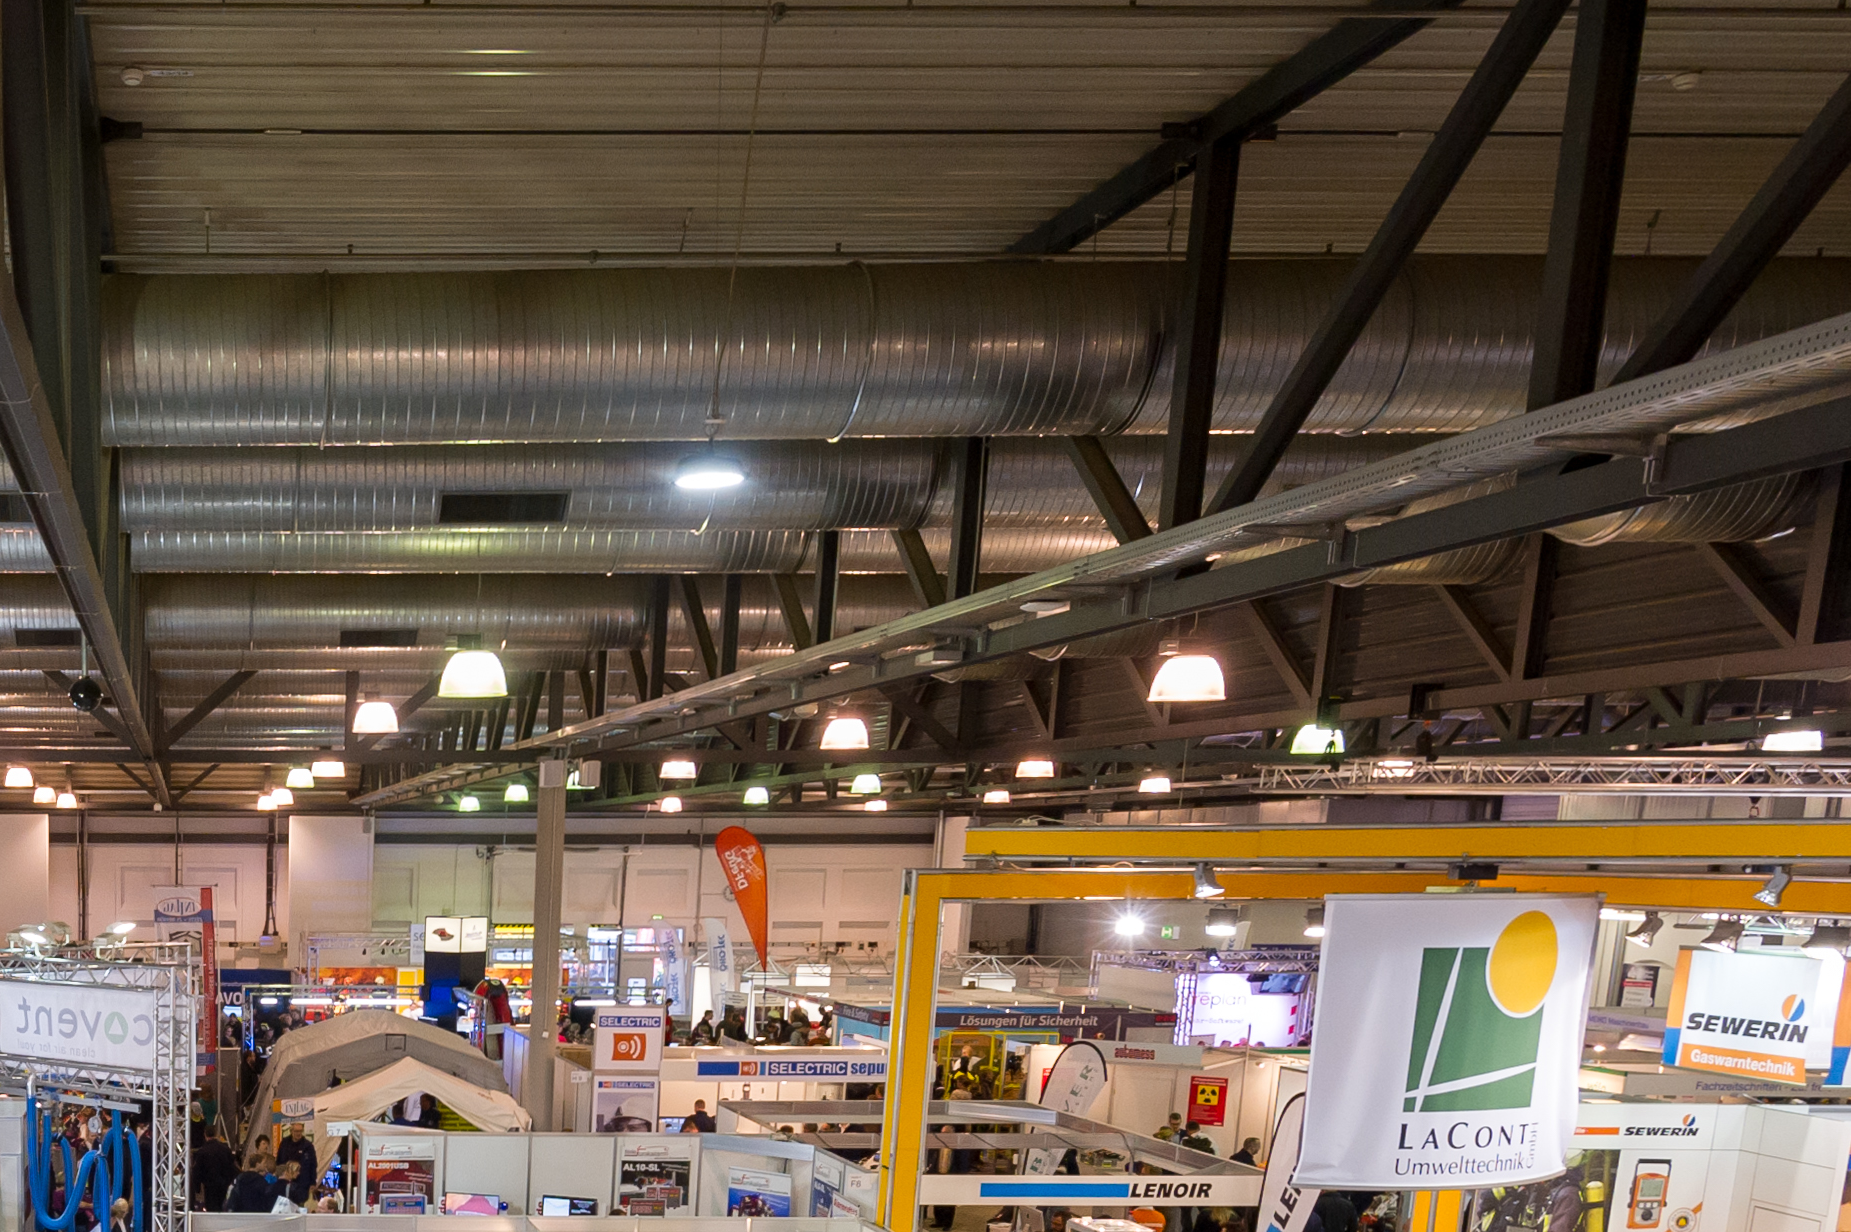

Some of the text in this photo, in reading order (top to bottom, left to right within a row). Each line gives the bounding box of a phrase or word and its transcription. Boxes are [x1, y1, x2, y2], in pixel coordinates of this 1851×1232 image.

[600, 1016, 661, 1027] SELECTRIC
[960, 1014, 1098, 1029] Lösungen für Sicherheit
[1685, 1012, 1809, 1043] SEWERIN
[770, 1062, 846, 1075] SELECTRIC
[1690, 1048, 1796, 1077] Gaswarntechnik
[1695, 1081, 1782, 1092] Fachzeitschriften
[1623, 1126, 1700, 1137] SEWERIN
[622, 1162, 661, 1172] AL10-SL
[1394, 1152, 1524, 1176] Umwelttechnik
[1130, 1182, 1212, 1199] LENOIR
